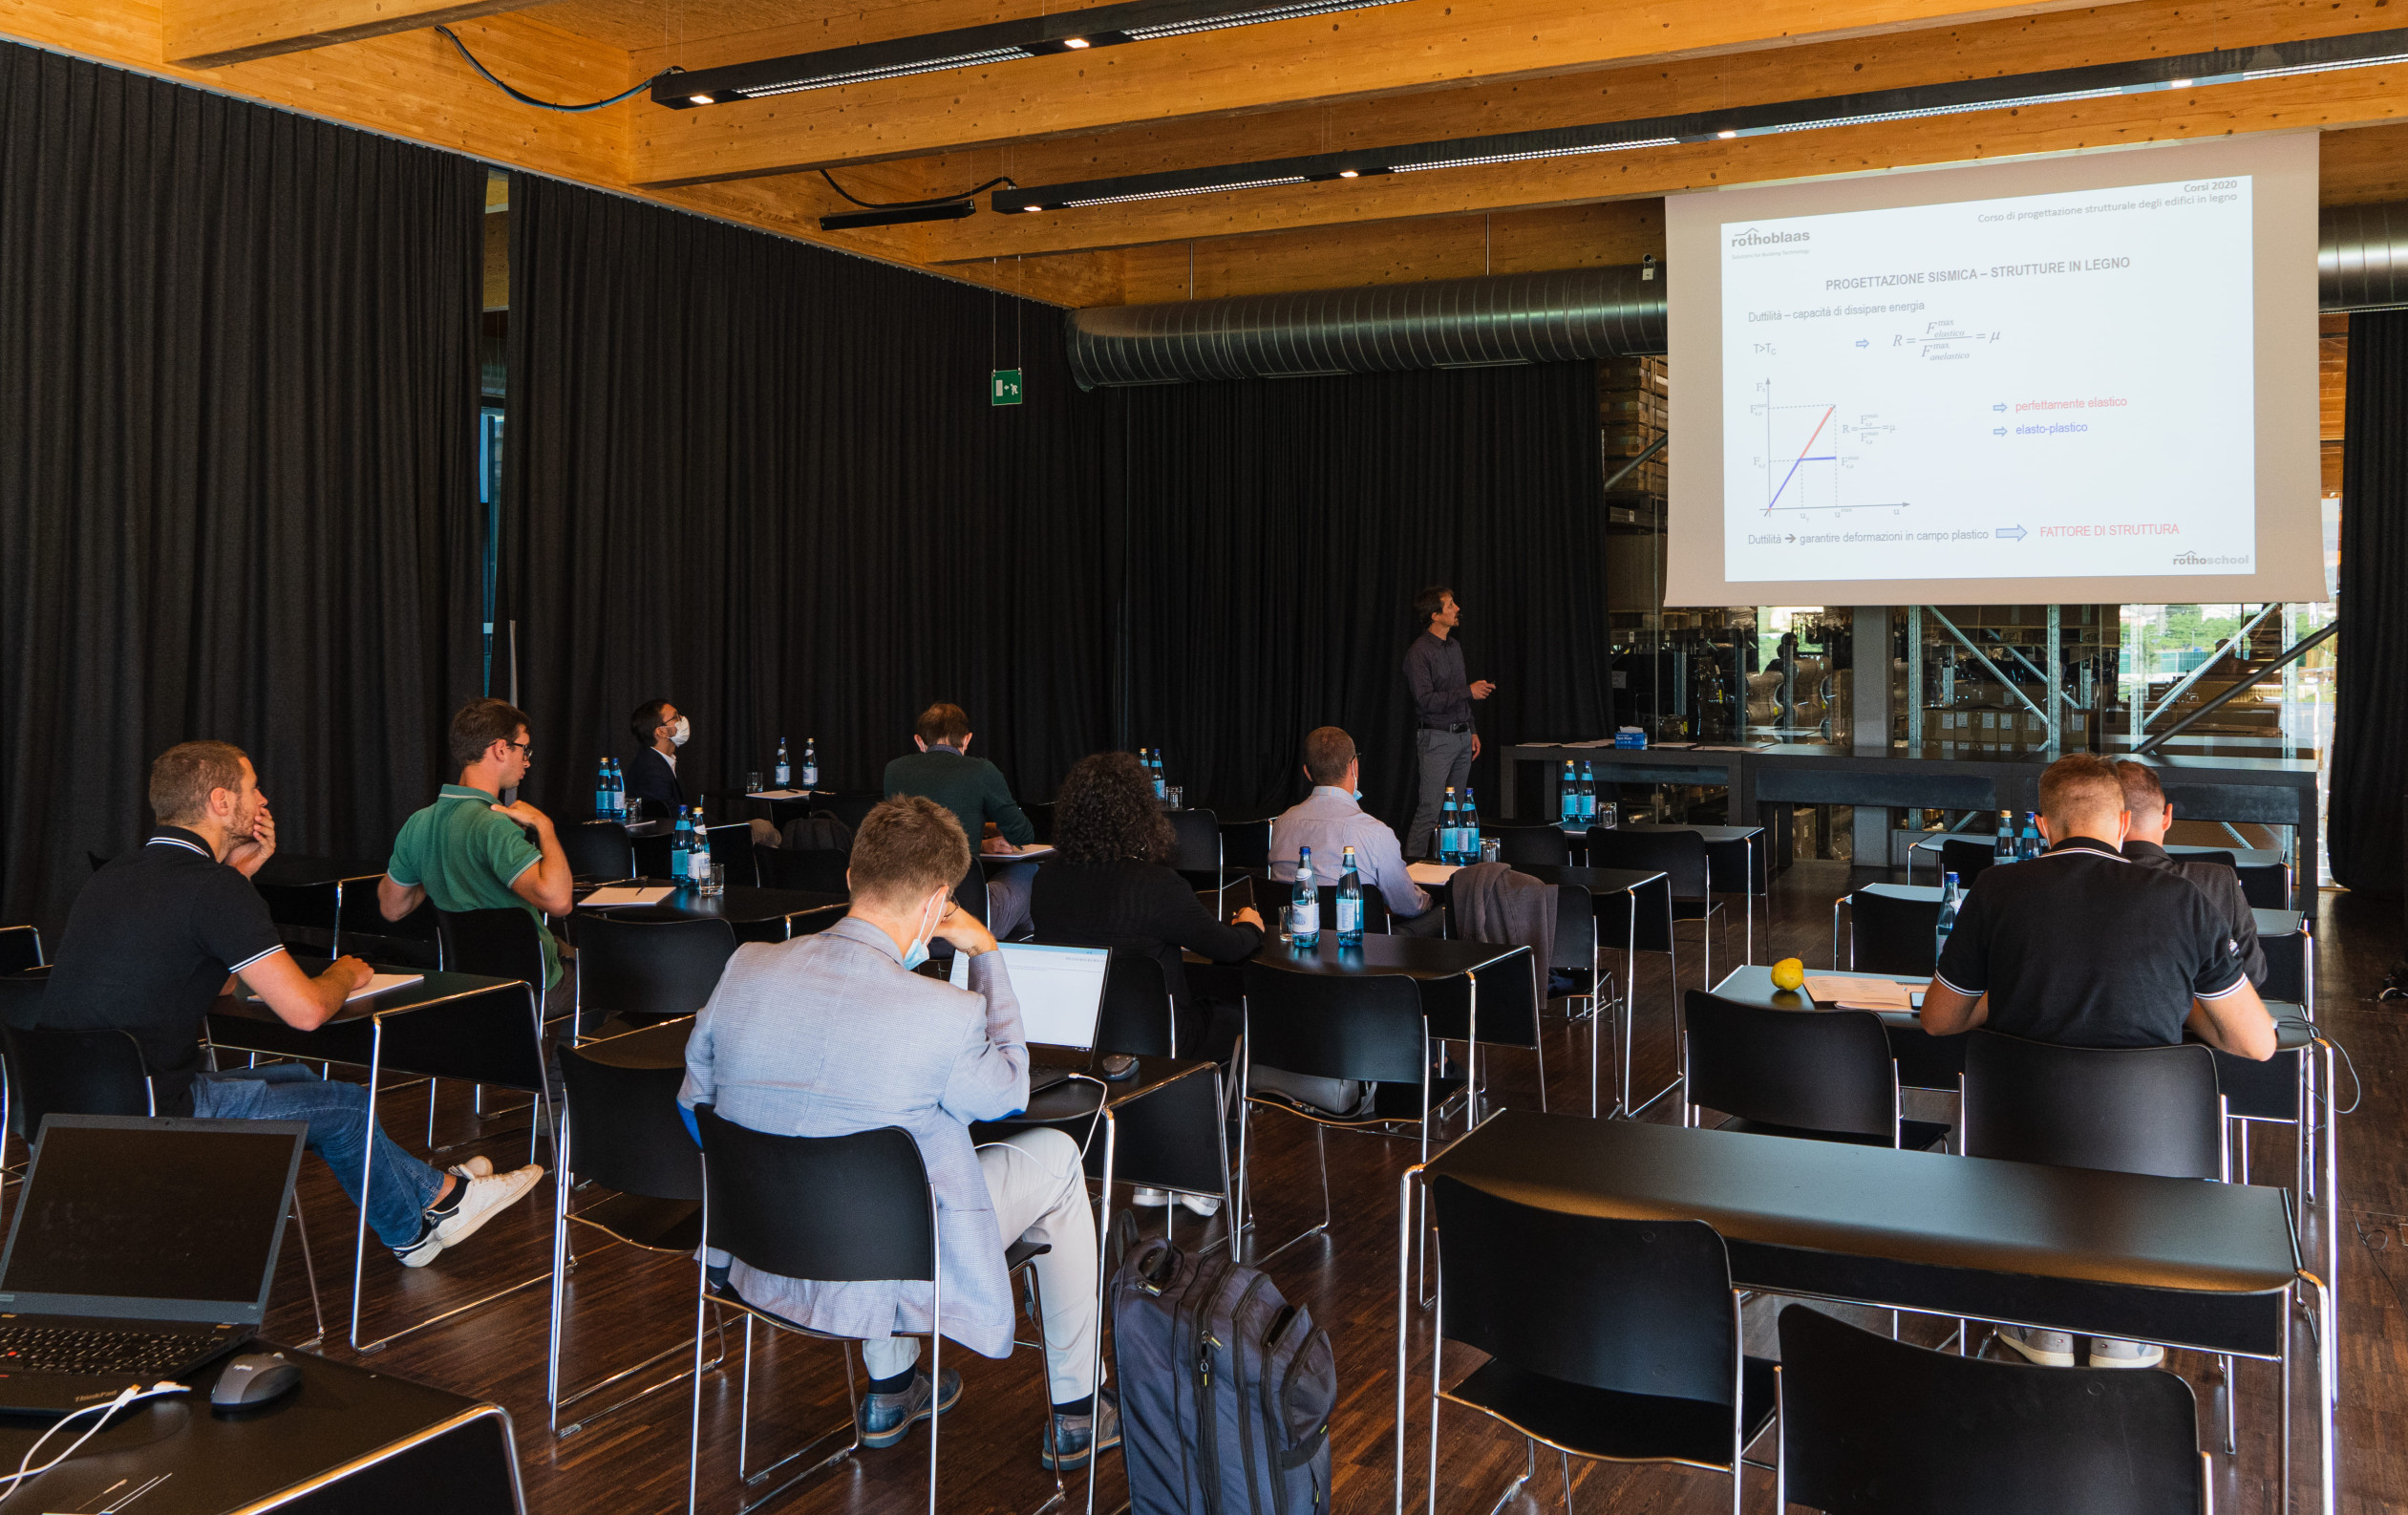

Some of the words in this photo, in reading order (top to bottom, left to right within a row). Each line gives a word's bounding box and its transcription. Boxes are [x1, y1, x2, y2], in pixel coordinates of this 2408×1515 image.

[2184, 182, 2209, 193] Corsi
[2211, 180, 2238, 191] 2020
[1977, 213, 2005, 223] Corso
[2006, 210, 2015, 221] di
[2017, 206, 2083, 221] progettazione
[2084, 201, 2137, 214] strutturale
[2139, 197, 2163, 210] degli
[2164, 195, 2195, 207] edifici
[2197, 194, 2207, 203] in
[2208, 191, 2238, 204] legno
[1731, 230, 1811, 247] rothoblaas
[1825, 272, 1925, 291] PROGETTAZIONE
[1928, 268, 1977, 283] SISMICA
[1991, 261, 2065, 278] STRUTTURE
[2069, 260, 2081, 272] IN
[2084, 256, 2131, 271] LEGNO
[1748, 309, 1782, 323] Duttilità
[1793, 306, 1832, 321] capacità
[1834, 305, 1843, 316] di
[1844, 303, 1886, 318] dissipare
[1888, 300, 1925, 314] energia
[2015, 398, 2085, 414] perfettamente
[2087, 396, 2128, 408] elastico
[2015, 422, 2088, 436] elasto-plastico
[1748, 533, 1782, 545] Duttilità
[1800, 533, 1841, 545] garantire
[1843, 531, 1903, 543] deformazioni
[1906, 530, 1914, 542] in
[1916, 532, 1950, 544] campo
[1951, 528, 1989, 542] plastico
[2040, 525, 2091, 538] FATTORE
[2095, 525, 2106, 537] DI
[2109, 523, 2180, 536] STRUTTURA
[2173, 554, 2249, 565] rothoschool
